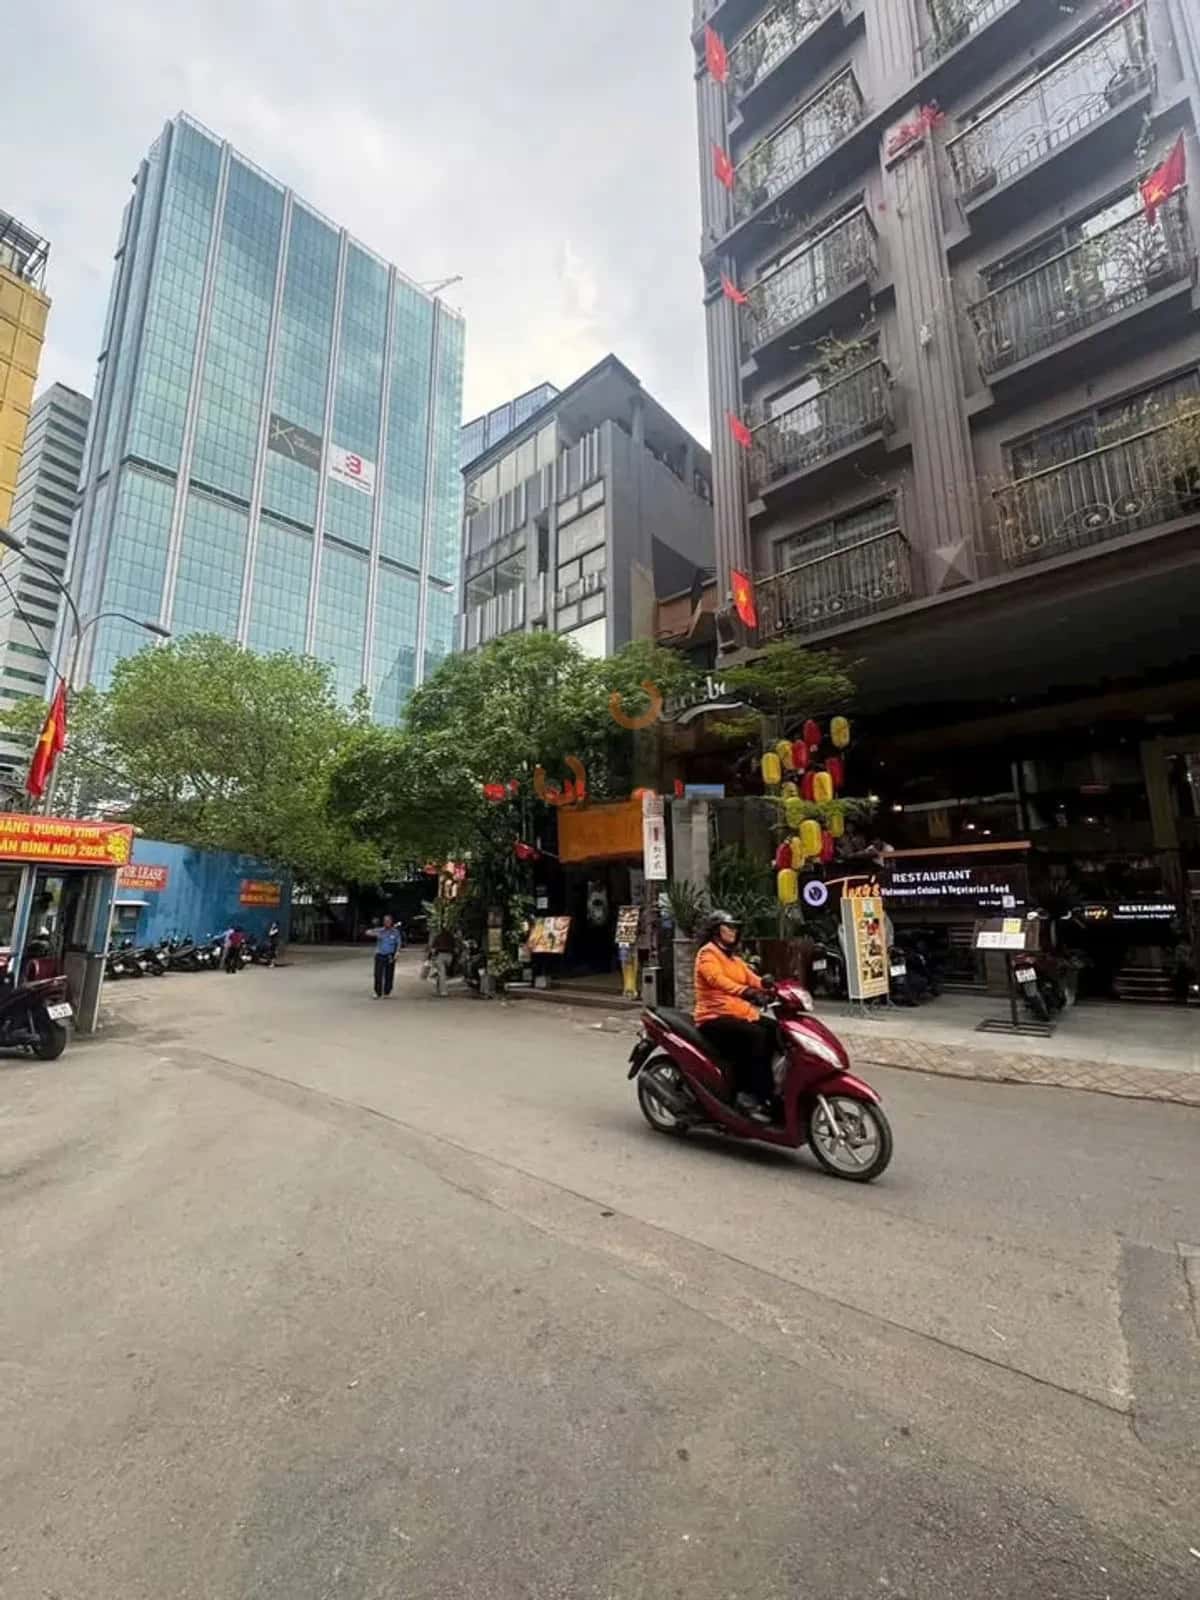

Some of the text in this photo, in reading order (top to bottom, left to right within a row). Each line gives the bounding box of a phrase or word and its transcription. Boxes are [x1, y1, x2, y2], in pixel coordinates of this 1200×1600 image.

[33, 822, 72, 837] QUANG
[892, 869, 972, 883] RESTAURANT
[948, 884, 989, 896] Vegetarian
[990, 883, 1010, 894] Food
